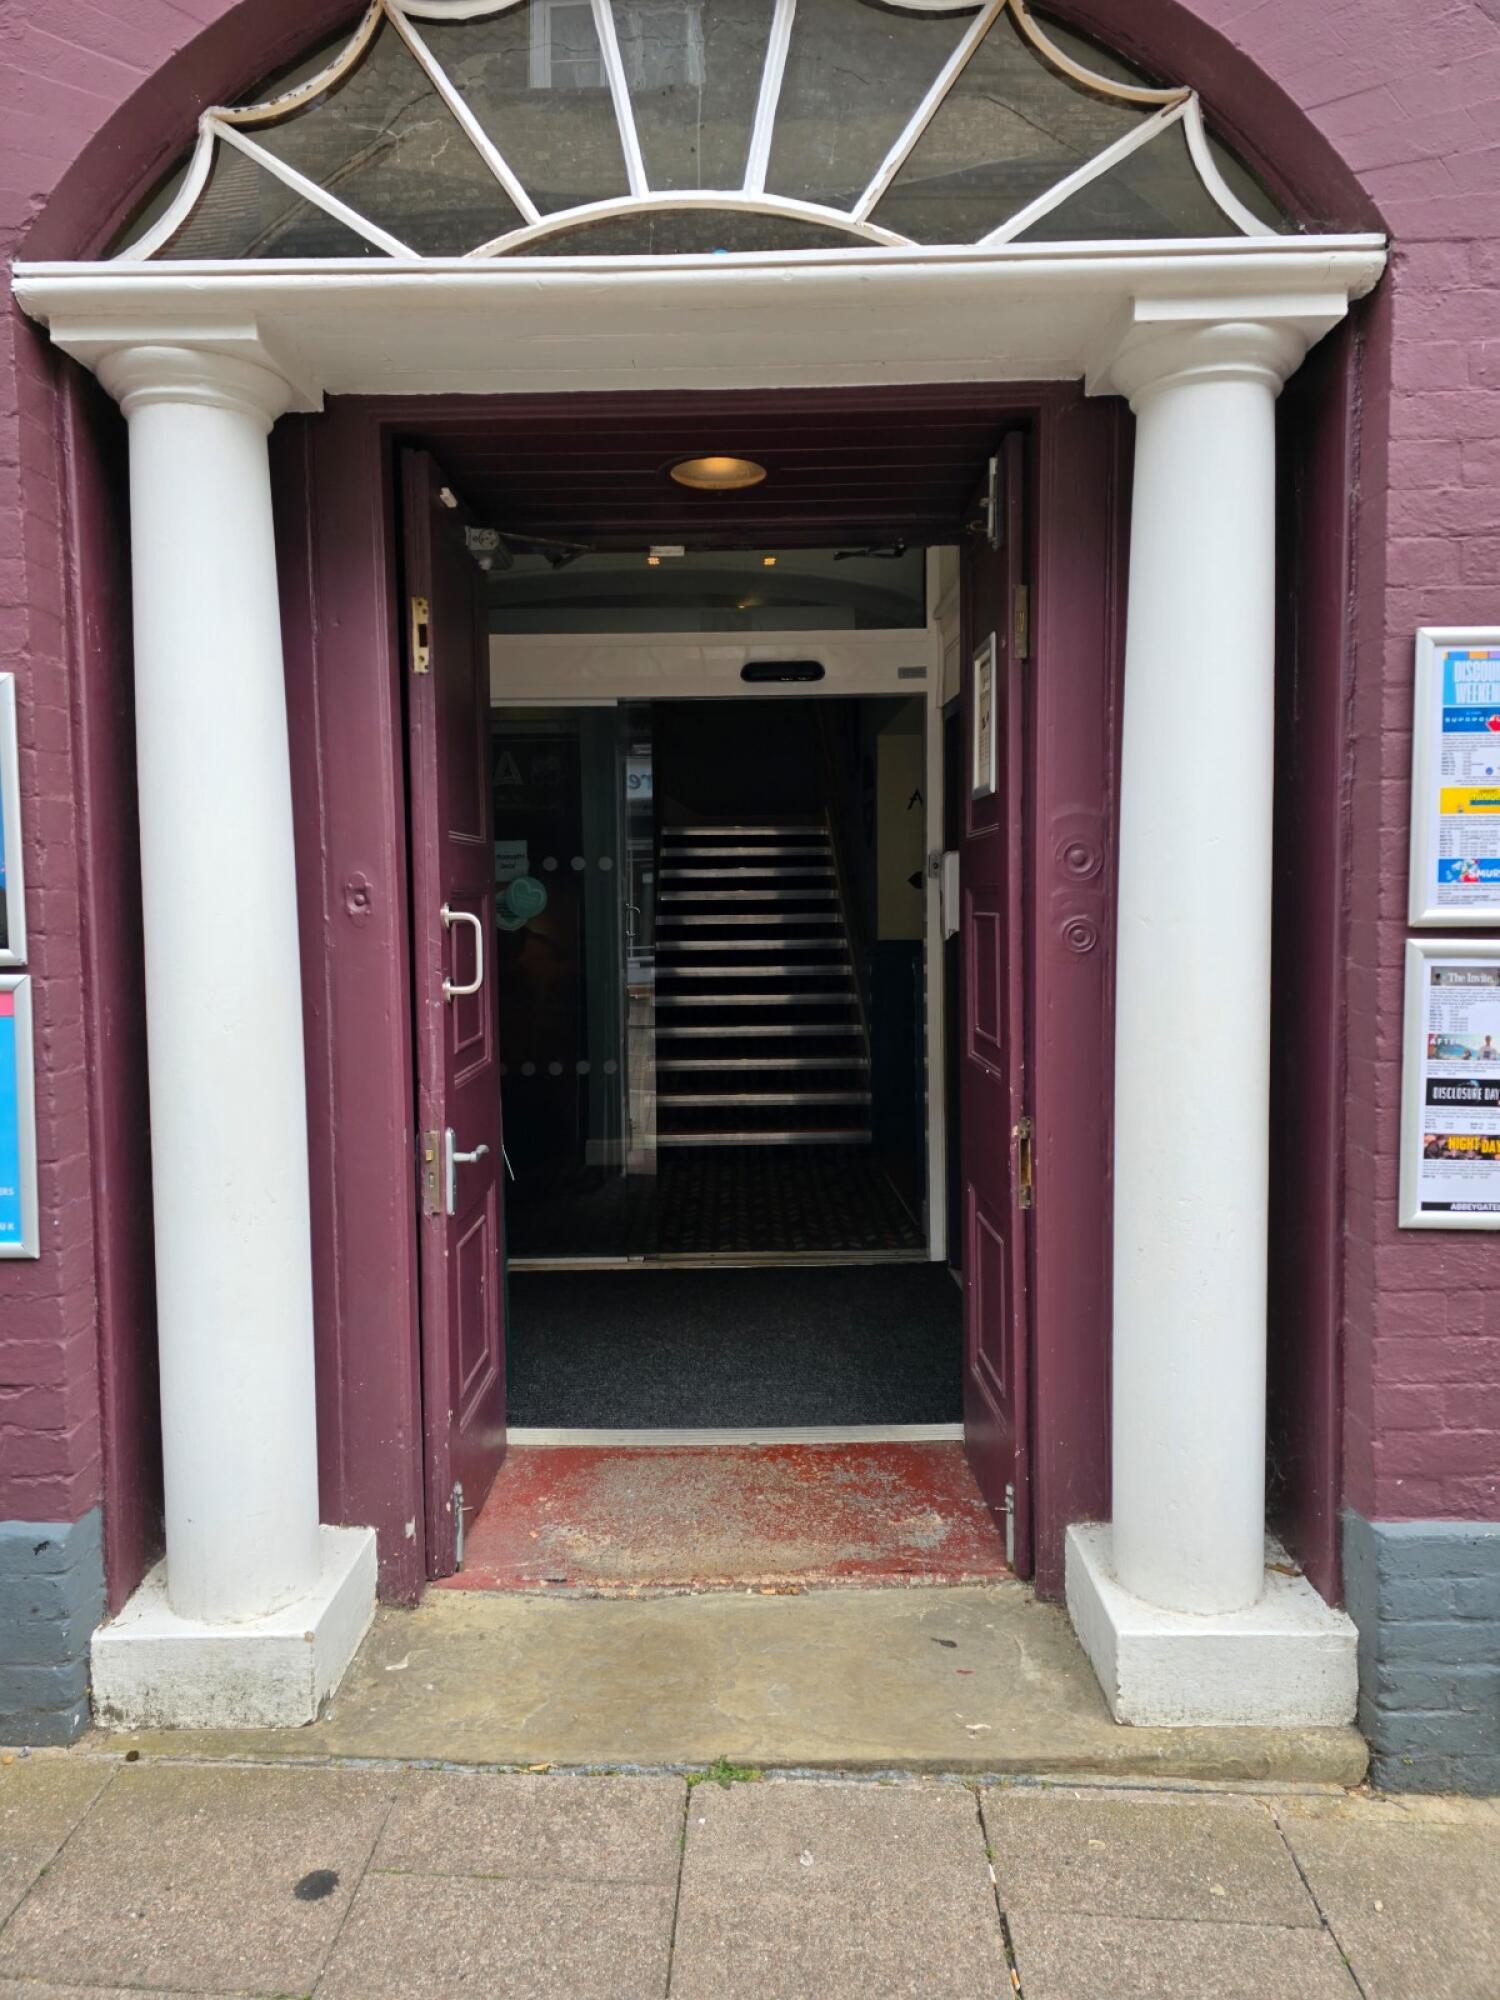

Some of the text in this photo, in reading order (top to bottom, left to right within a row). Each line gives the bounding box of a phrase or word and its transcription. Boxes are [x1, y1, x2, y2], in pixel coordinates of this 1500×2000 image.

[1448, 972, 1465, 984] The
[1432, 1086, 1482, 1100] DISCLOSURE
[1448, 1135, 1480, 1151] NIGHT
